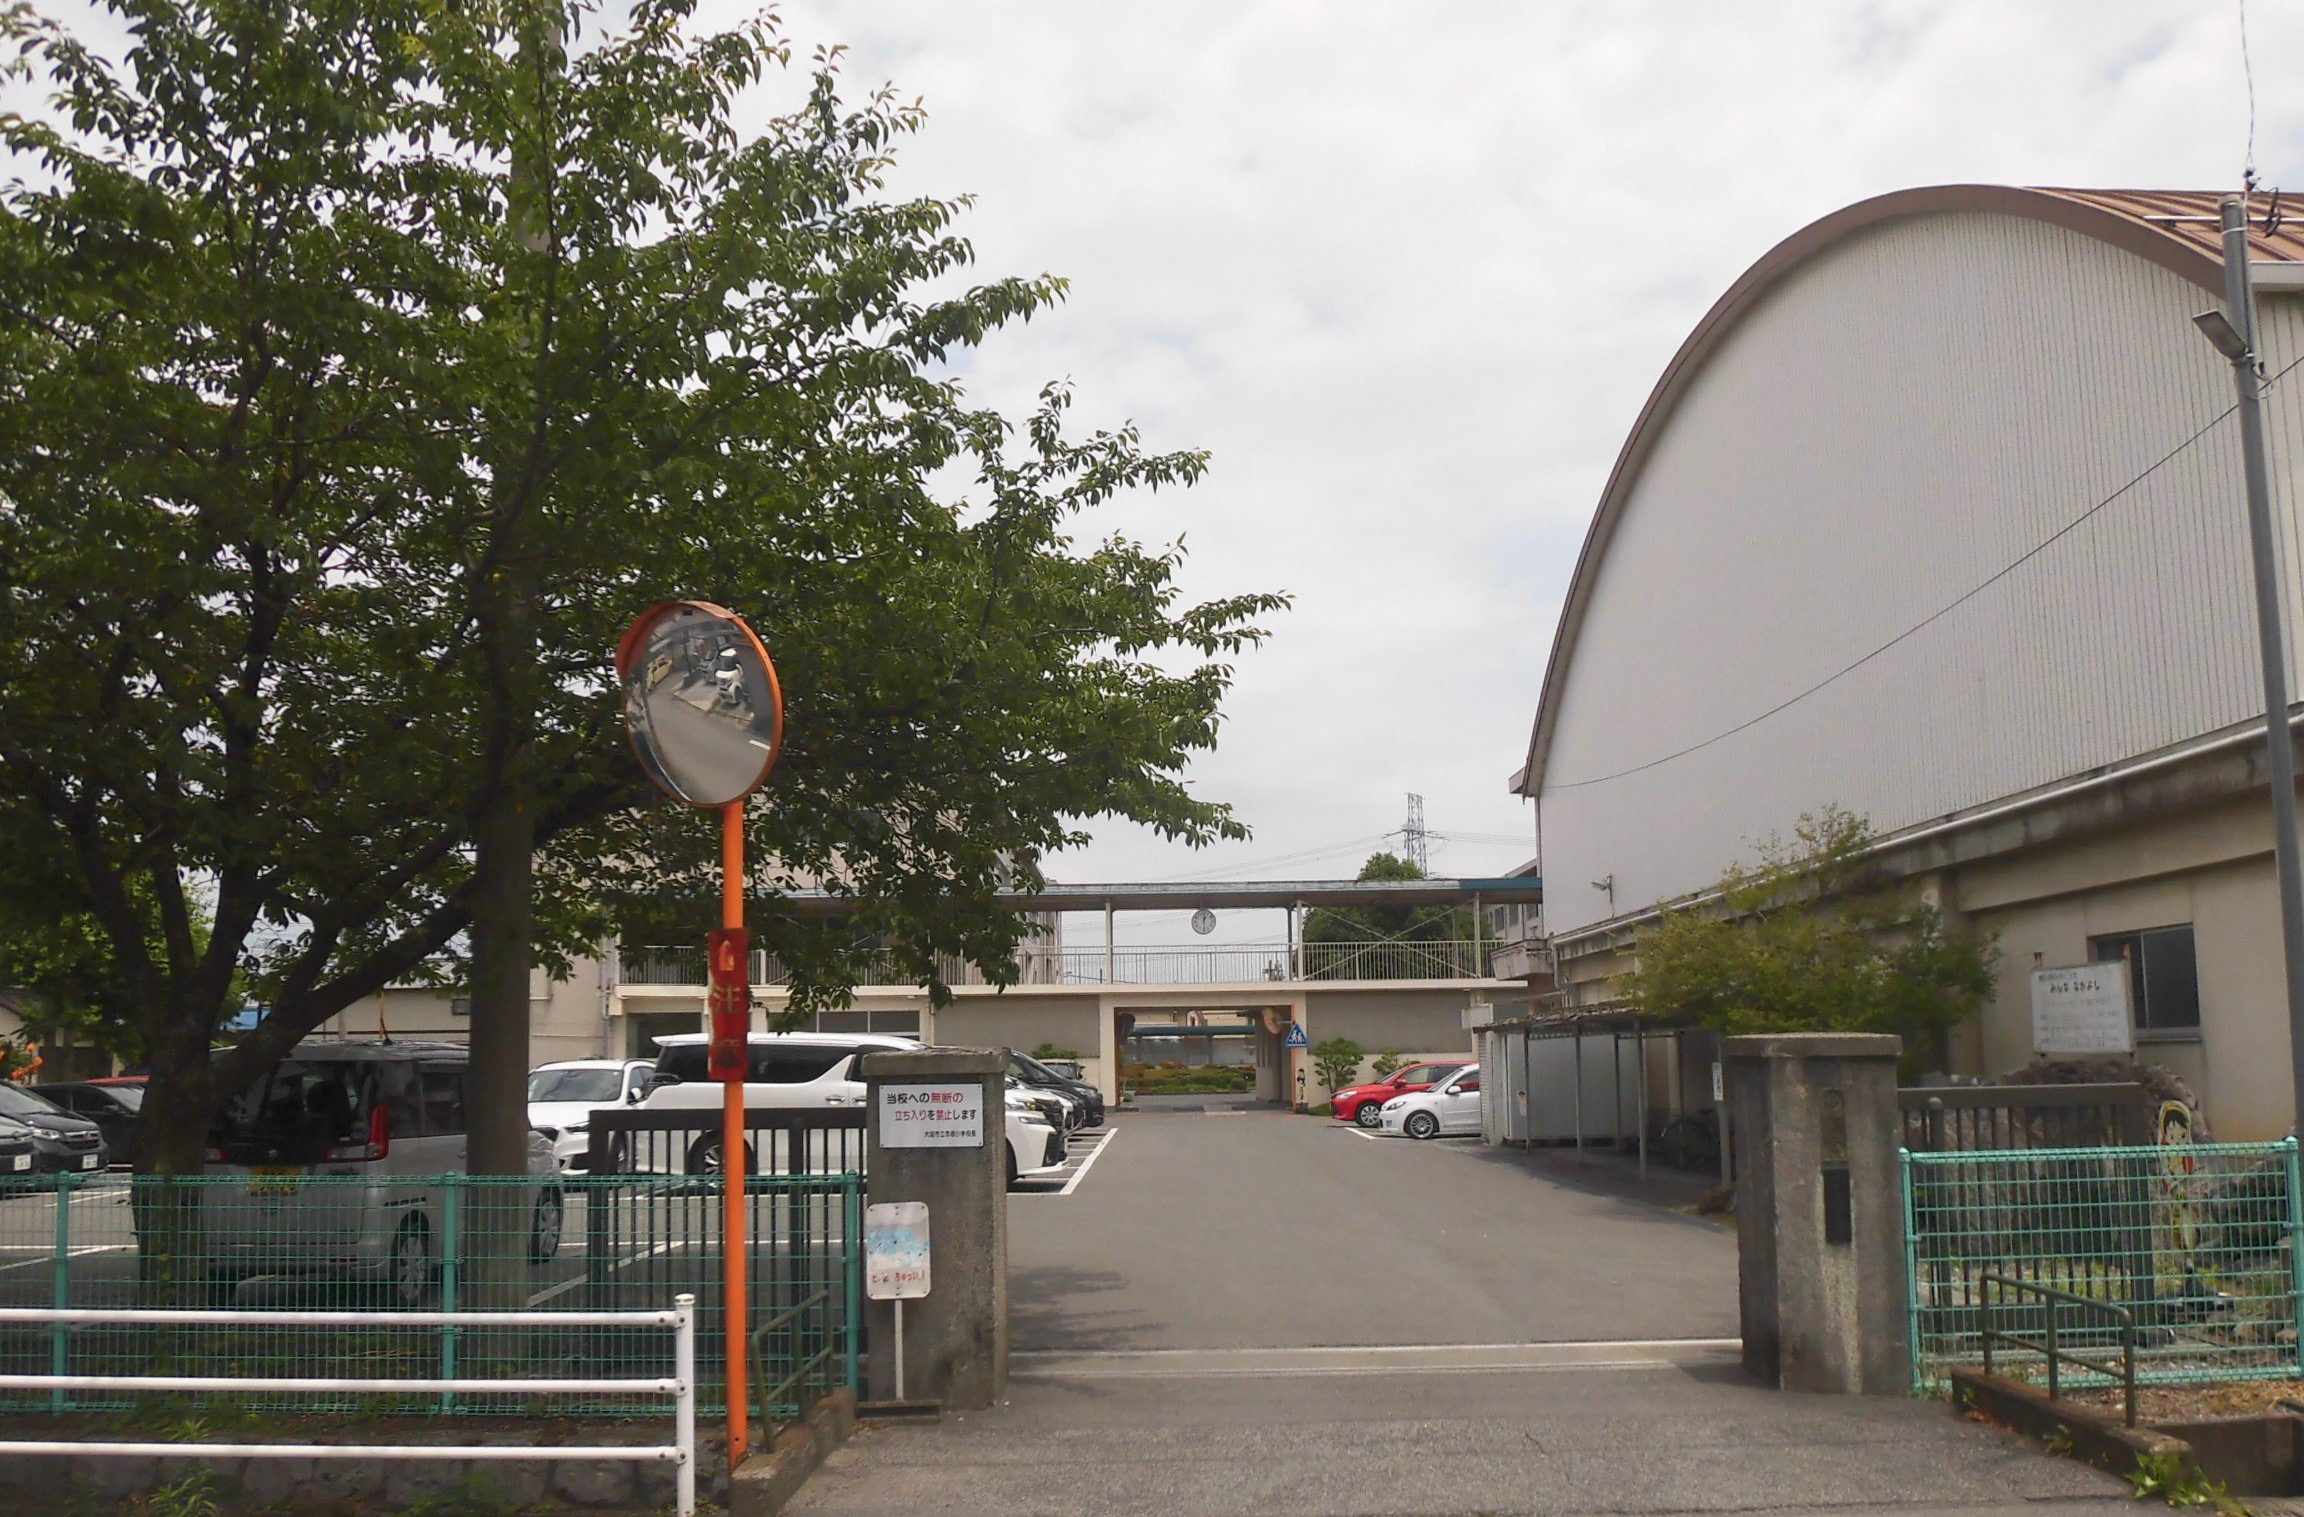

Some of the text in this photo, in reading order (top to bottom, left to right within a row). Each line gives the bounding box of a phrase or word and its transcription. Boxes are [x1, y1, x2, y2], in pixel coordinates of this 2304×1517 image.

[887, 1092, 964, 1104] 当校への無断の
[895, 1109, 977, 1121] 立ち入りを禁止します
